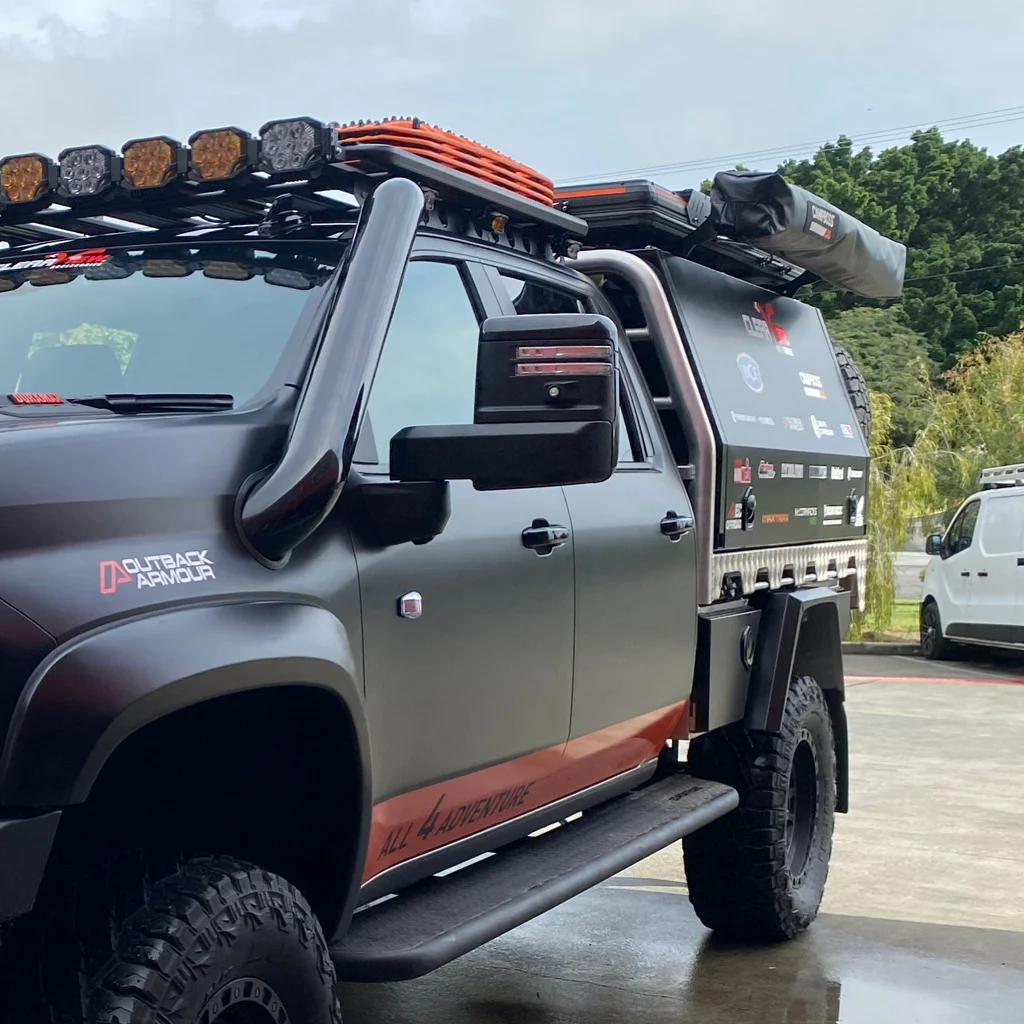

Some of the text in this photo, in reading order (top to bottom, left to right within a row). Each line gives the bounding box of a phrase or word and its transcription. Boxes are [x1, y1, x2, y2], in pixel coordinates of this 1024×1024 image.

[122, 549, 213, 574] OUTBACK
[137, 565, 216, 589] ARMOUR
[377, 782, 535, 859] ALL 4 ADVENTURE
